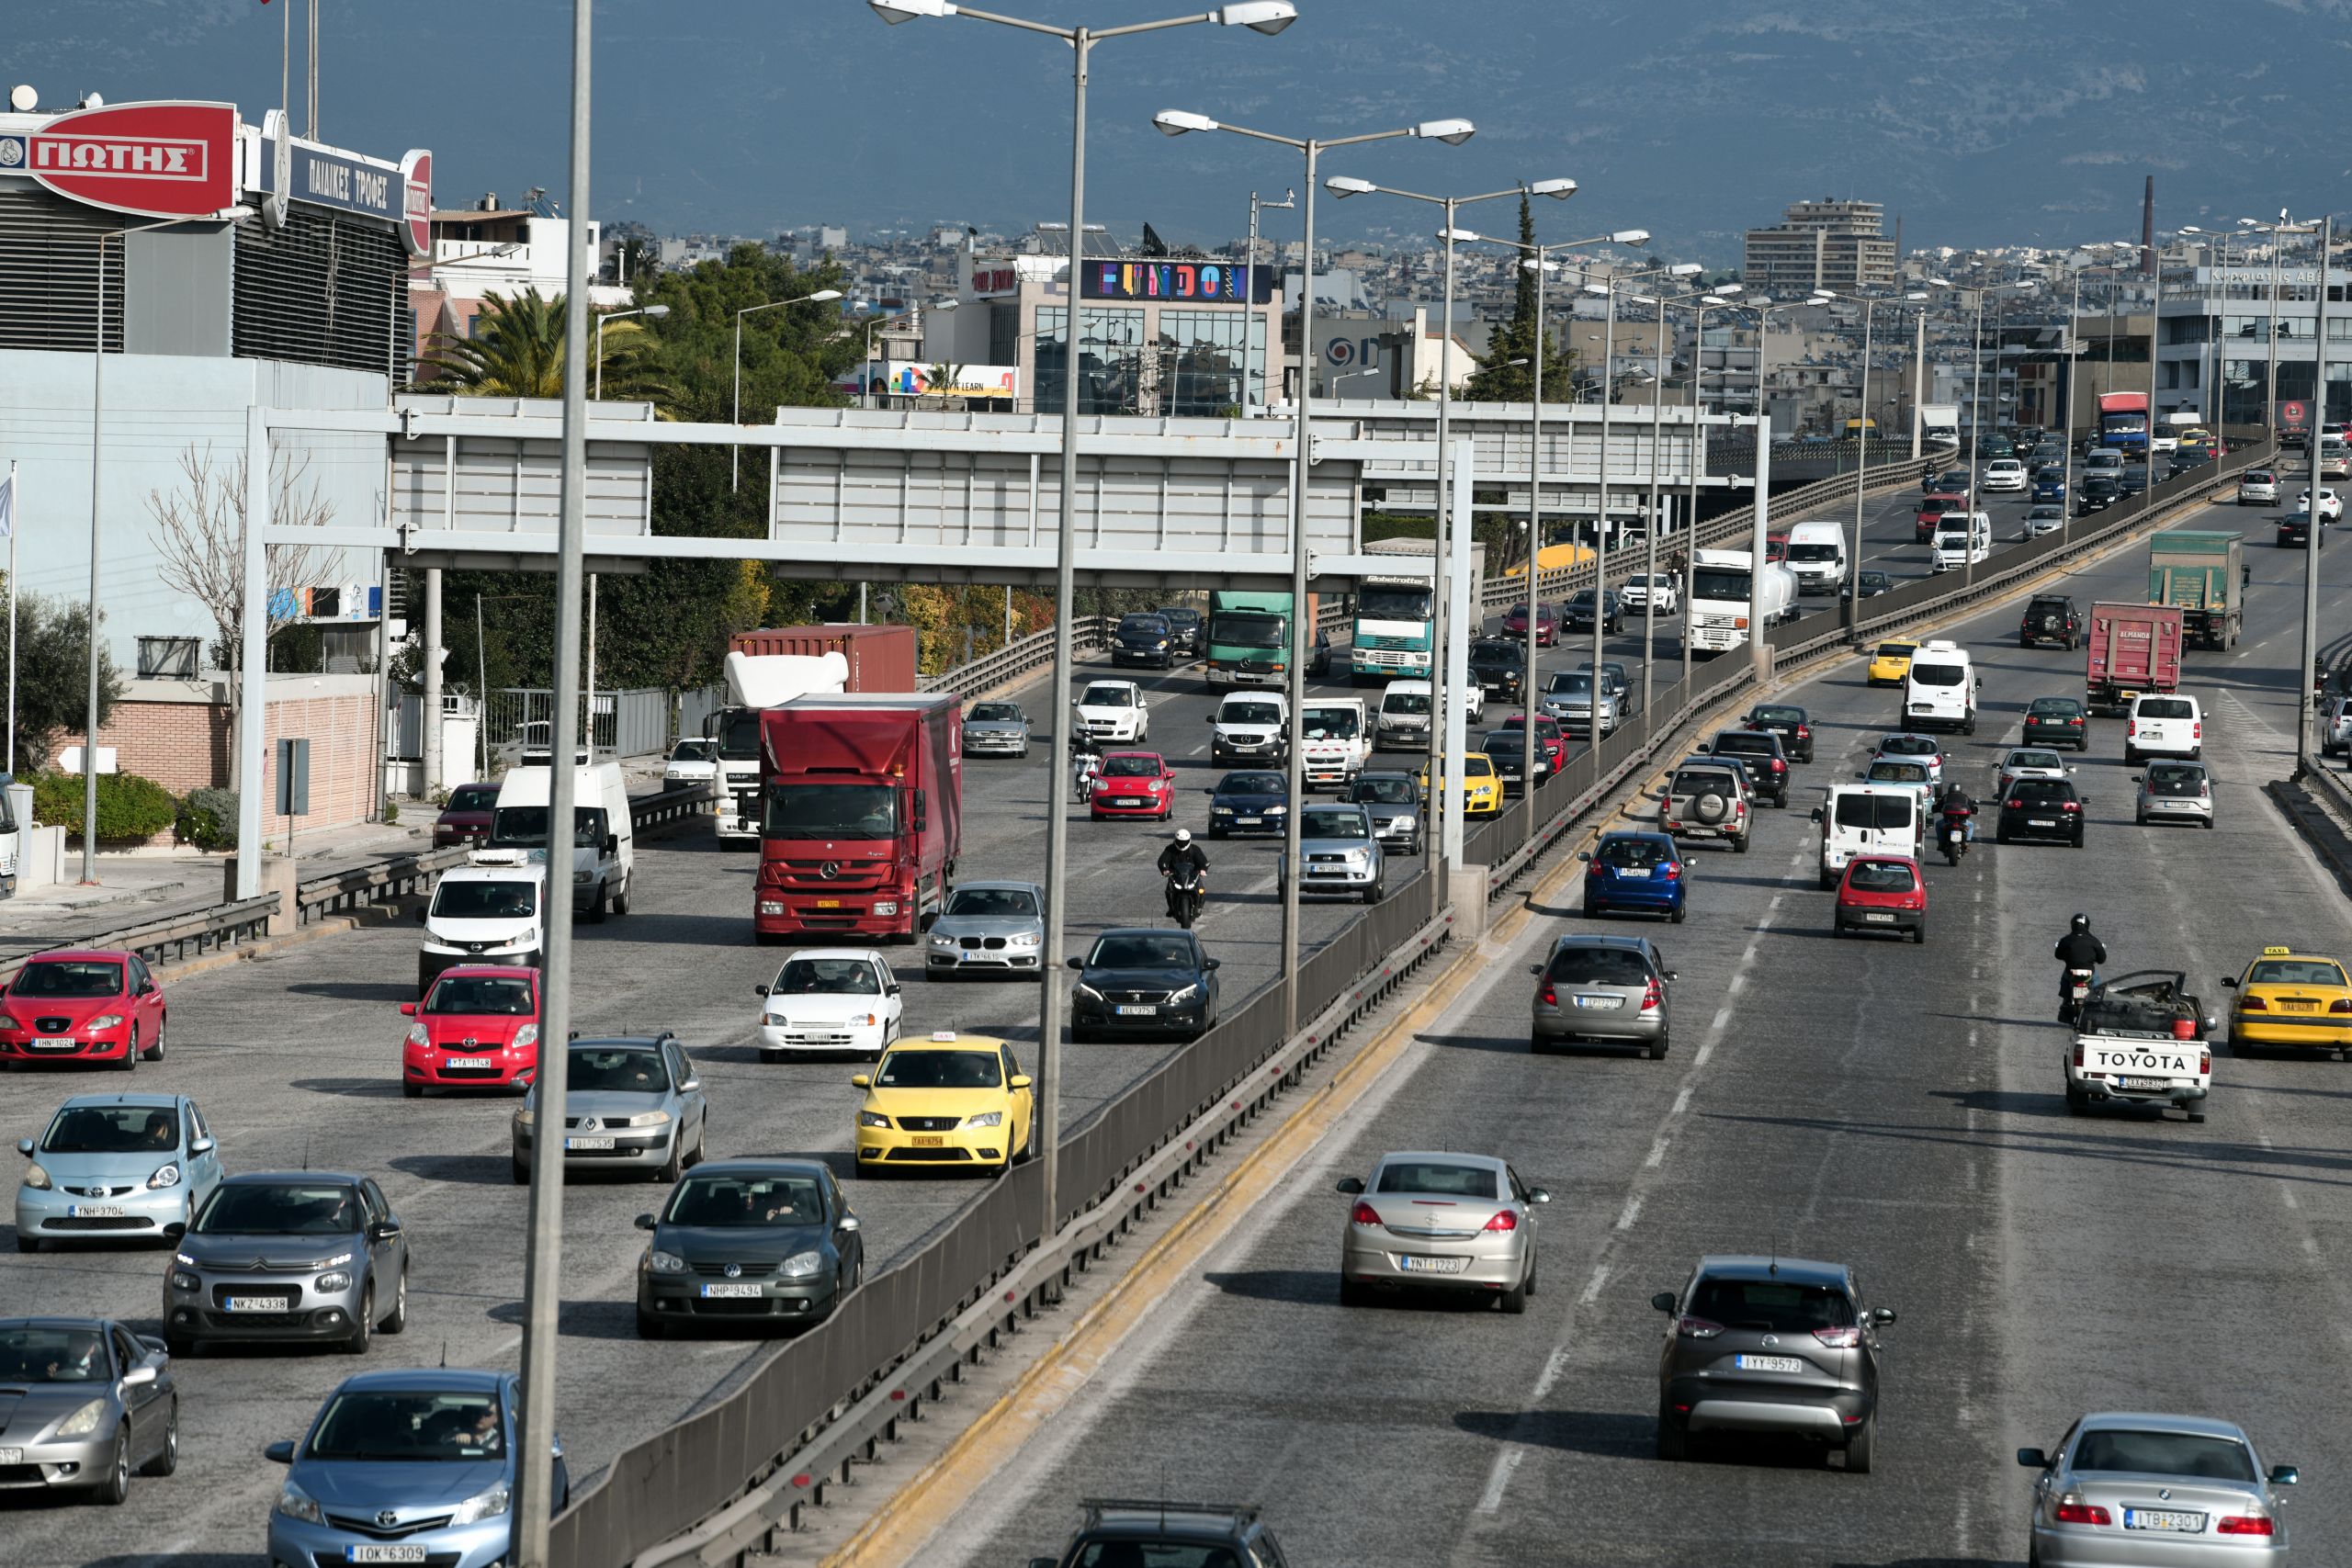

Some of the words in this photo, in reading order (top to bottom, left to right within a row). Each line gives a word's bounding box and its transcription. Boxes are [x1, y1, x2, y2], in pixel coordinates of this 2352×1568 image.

[37, 141, 187, 173] ΓΙΩΤΗΣ
[309, 158, 350, 201] ΠΑΙΔΙΚΕΣ
[355, 169, 388, 209] ΤΡΟΦΕΣ
[961, 382, 984, 392] LEARN
[1366, 575, 1426, 585] Globetrotter
[2098, 1053, 2186, 1069] TOYOTA
